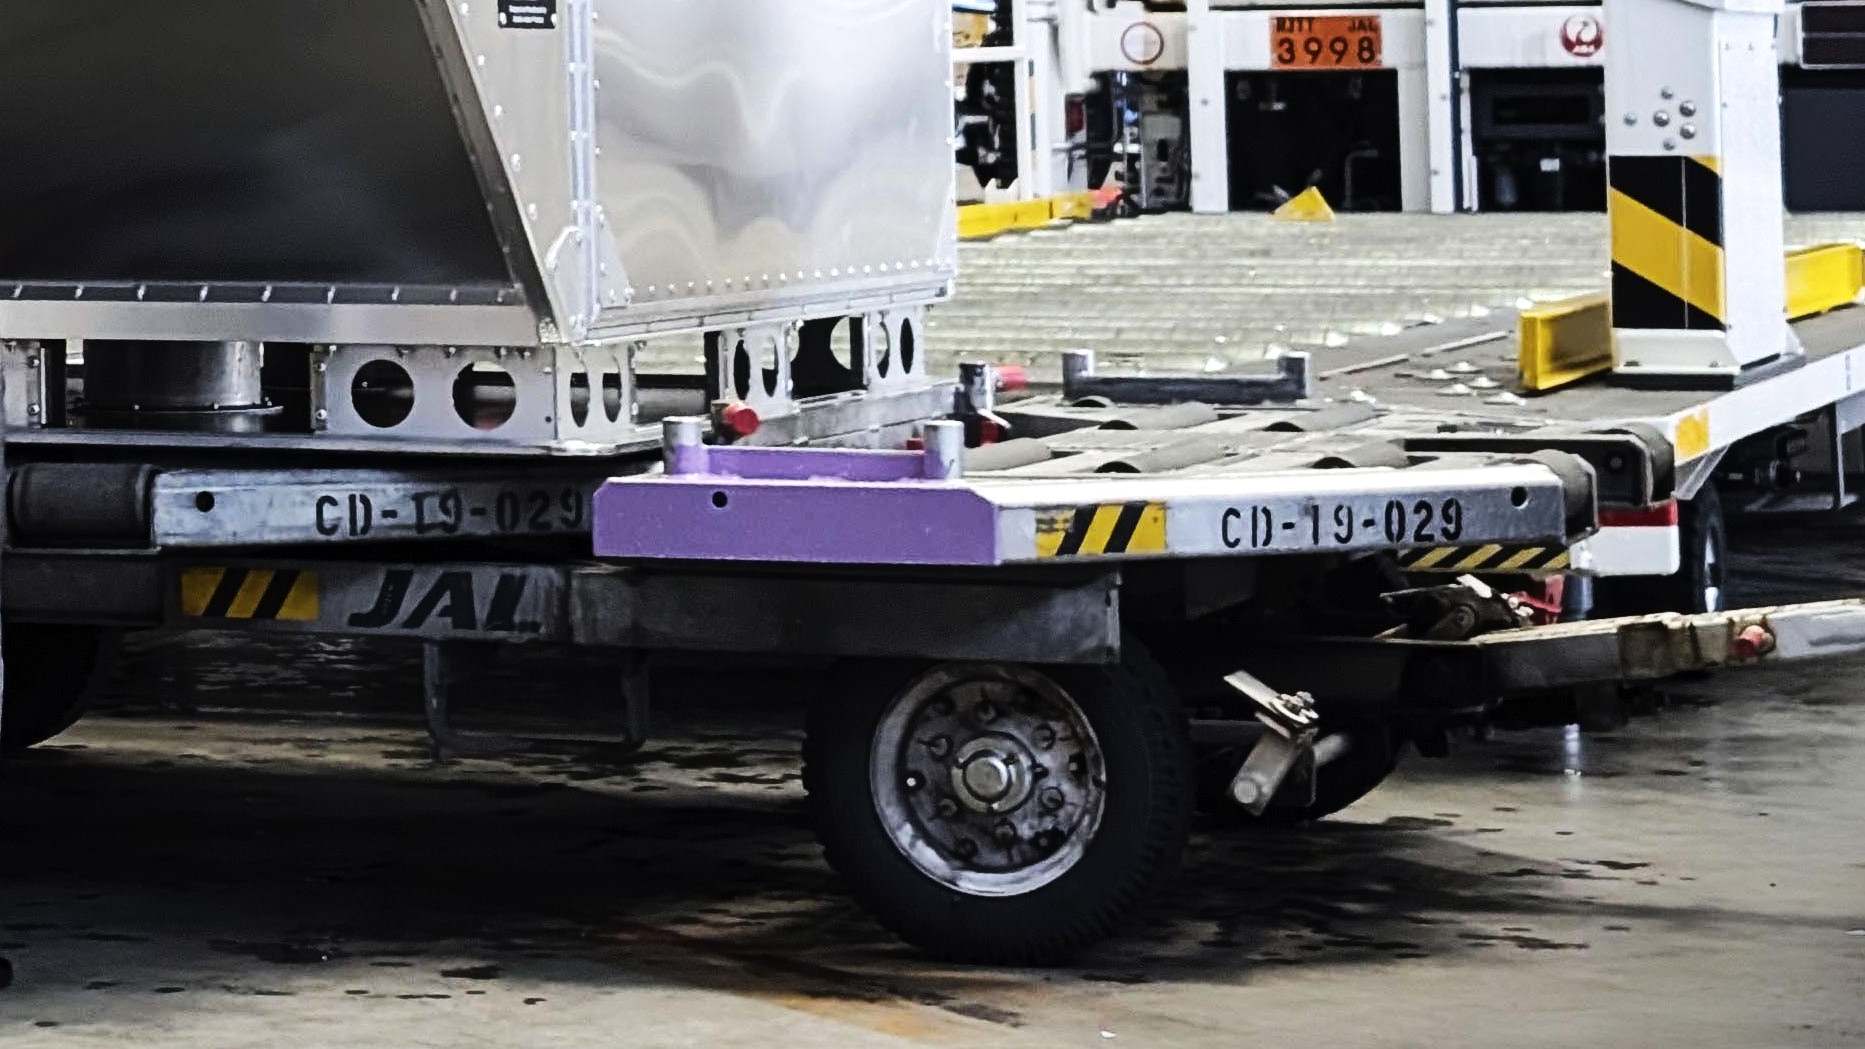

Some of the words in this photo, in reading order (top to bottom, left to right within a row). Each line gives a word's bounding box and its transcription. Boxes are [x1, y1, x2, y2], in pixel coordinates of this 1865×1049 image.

[1277, 37, 1376, 64] 3998
[315, 487, 584, 537] CD-19-029
[1221, 498, 1463, 549] CD-19-029
[347, 569, 542, 633] JAL
